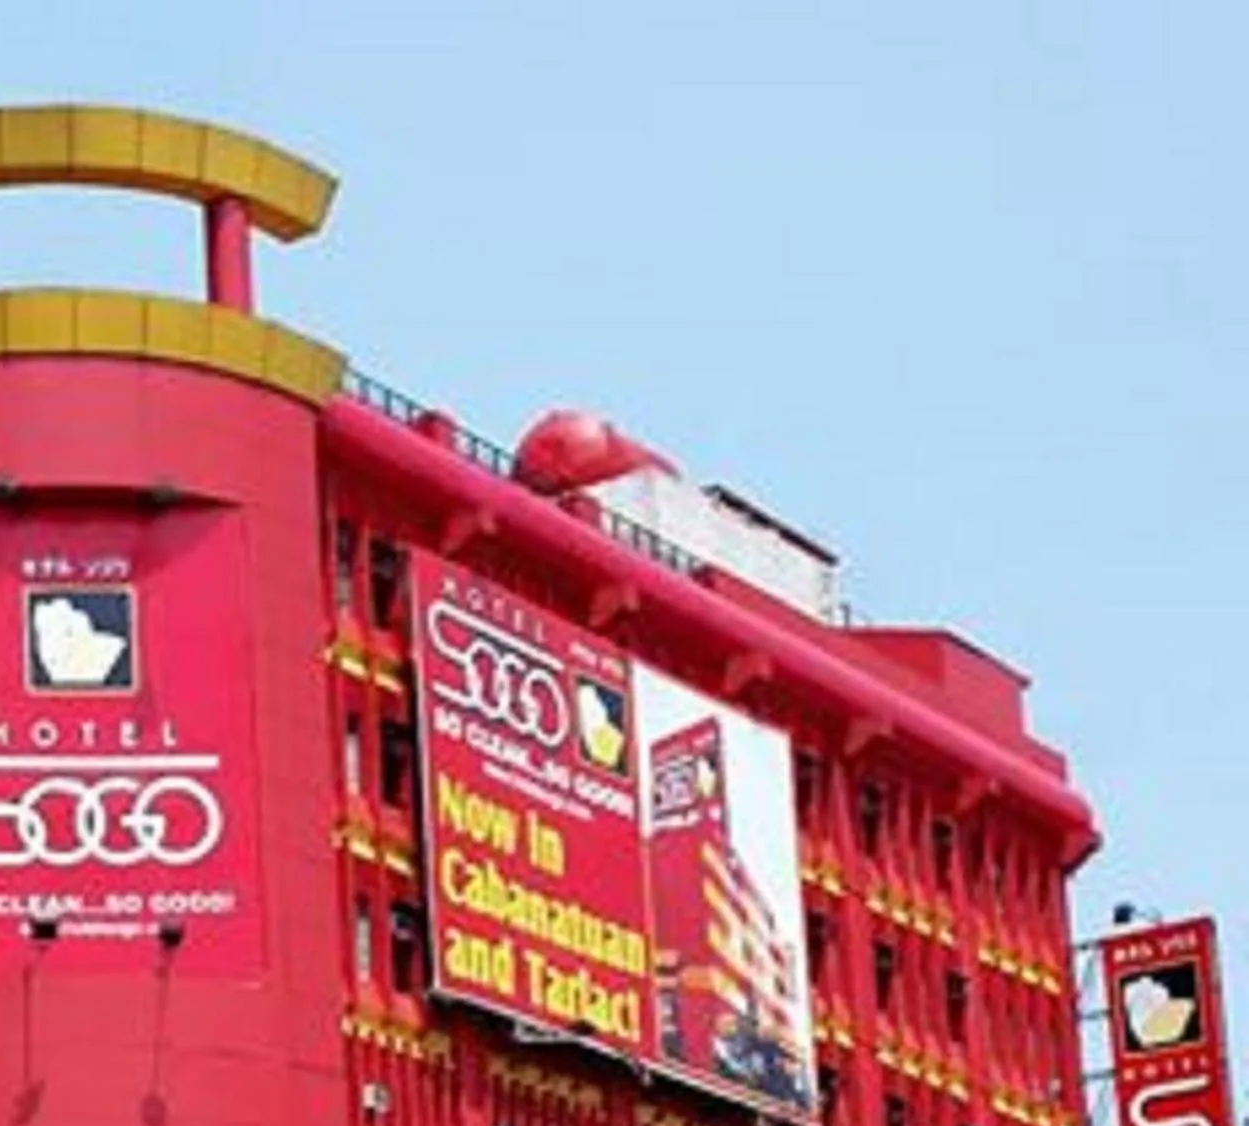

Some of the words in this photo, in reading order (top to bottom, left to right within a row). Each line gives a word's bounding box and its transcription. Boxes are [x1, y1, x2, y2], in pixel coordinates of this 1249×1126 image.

[428, 602, 570, 748] SOGO
[437, 771, 517, 855] Now
[440, 846, 647, 977] Cabanatuan
[444, 925, 518, 997] and
